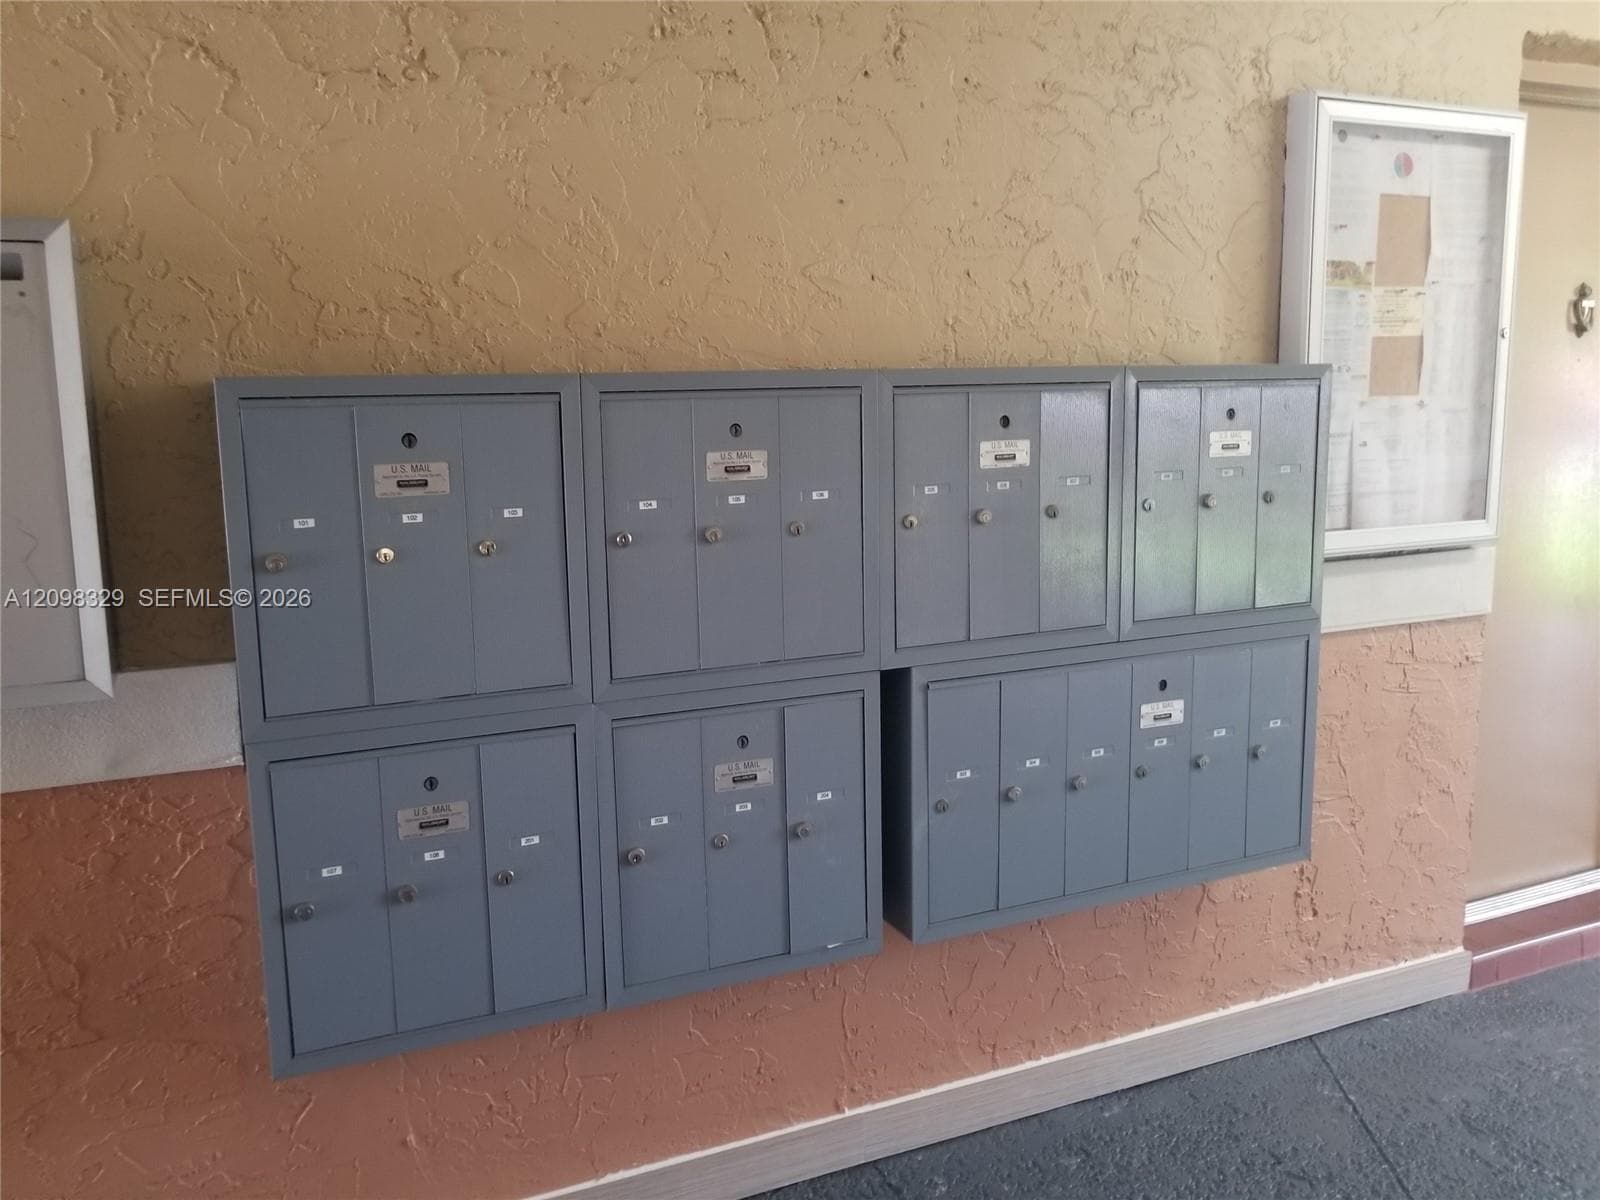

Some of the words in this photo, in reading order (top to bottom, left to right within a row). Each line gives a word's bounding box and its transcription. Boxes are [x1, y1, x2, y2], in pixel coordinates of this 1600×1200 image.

[720, 451, 736, 460] U.S.
[736, 451, 754, 460] MAIL
[391, 464, 408, 474] U.S.
[410, 463, 432, 473] MAIL
[642, 501, 653, 509] 104
[406, 514, 418, 522] 102
[297, 519, 310, 527] 101
[727, 763, 743, 772] U.S.
[743, 760, 761, 770] MAIL
[432, 803, 453, 814] MAIL
